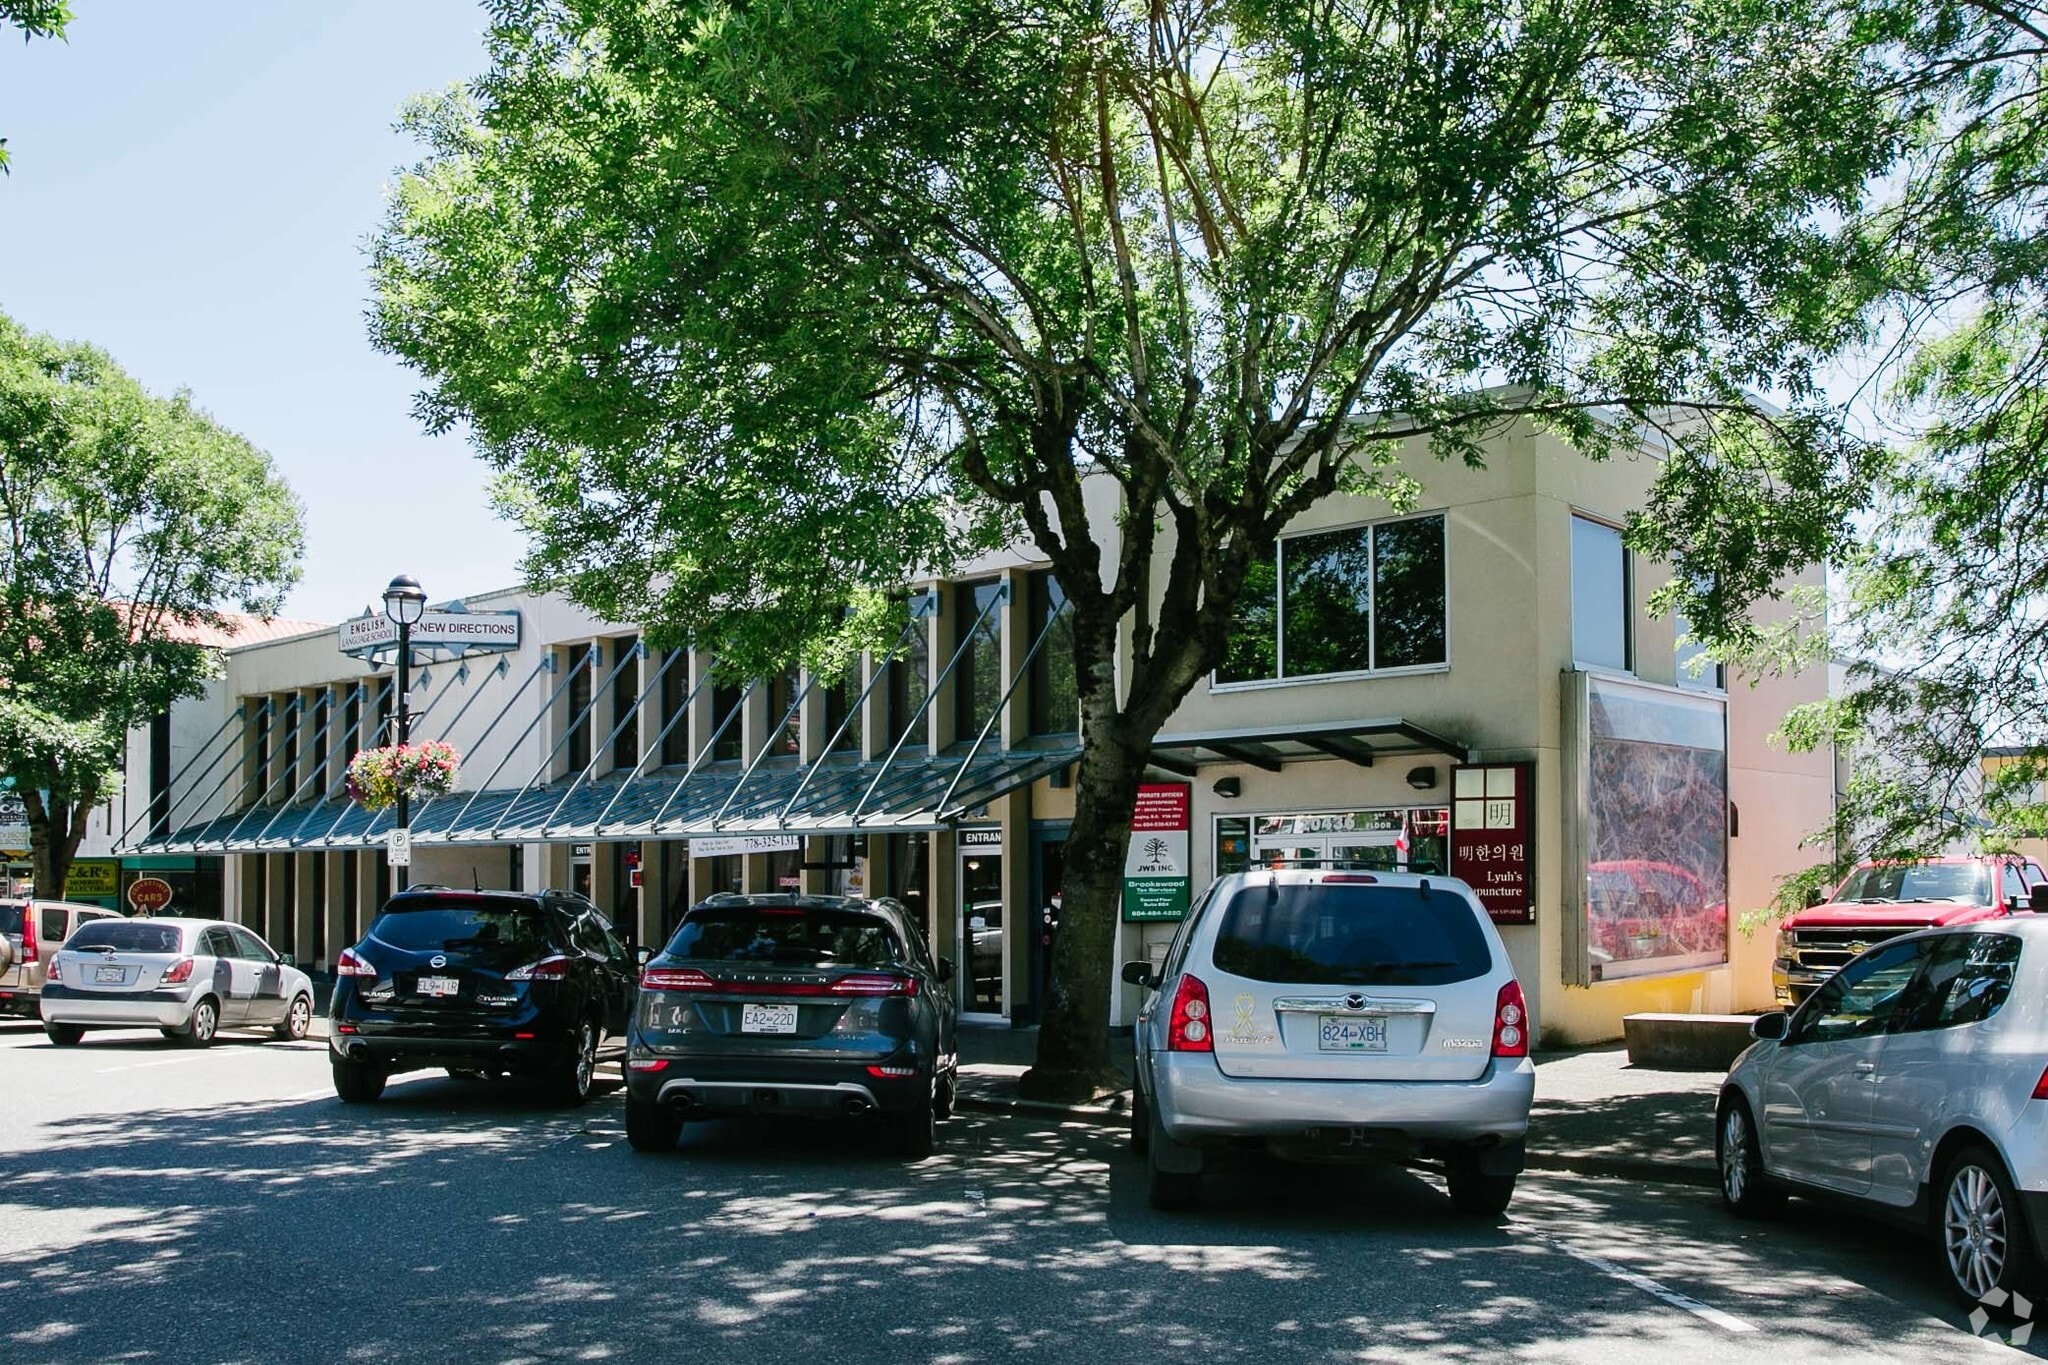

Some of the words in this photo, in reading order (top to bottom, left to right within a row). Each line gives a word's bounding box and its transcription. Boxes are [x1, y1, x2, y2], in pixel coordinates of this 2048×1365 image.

[351, 618, 385, 635] ENGLISH
[420, 623, 445, 633] NEW
[449, 623, 515, 634] DIRECTIONS
[1490, 803, 1511, 826] 明
[966, 833, 1001, 843] ENTRAN
[1487, 871, 1523, 883] Lyuh's
[137, 893, 162, 902] CARS
[718, 974, 826, 982] LINCOLN
